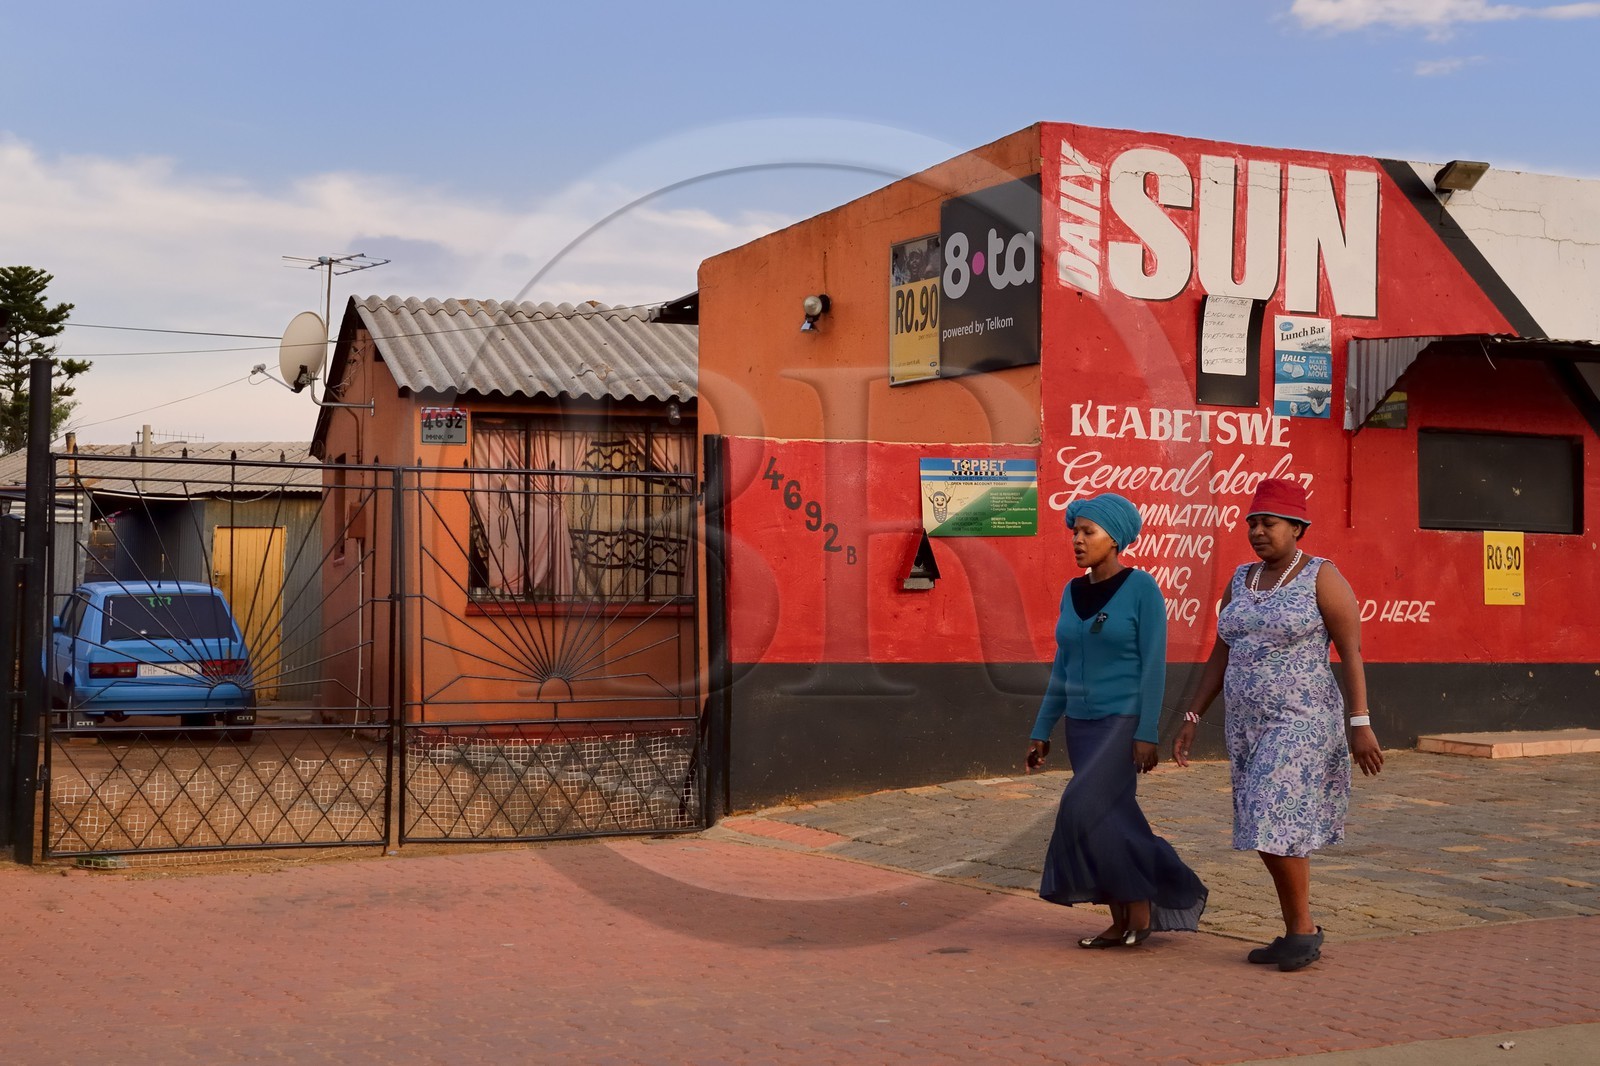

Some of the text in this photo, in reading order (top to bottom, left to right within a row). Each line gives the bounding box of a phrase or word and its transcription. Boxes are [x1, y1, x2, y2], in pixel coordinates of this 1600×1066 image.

[1058, 139, 1379, 320] DAILY SUN
[895, 283, 938, 335] R0.90
[942, 316, 1014, 342] powered by Telkom
[1280, 327, 1309, 342] Lunch
[1309, 326, 1326, 336] Bar
[1280, 353, 1307, 364] HALLS
[1308, 358, 1328, 366] MAKE
[423, 413, 463, 430] 4692
[1070, 399, 1291, 447] KEABETSWE
[1048, 446, 1214, 511] General
[1137, 503, 1241, 533] MINATING
[1122, 534, 1214, 565] RINTING
[1487, 544, 1521, 571] R0.90
[1165, 597, 1200, 628] ING
[1379, 600, 1436, 623] HERE
